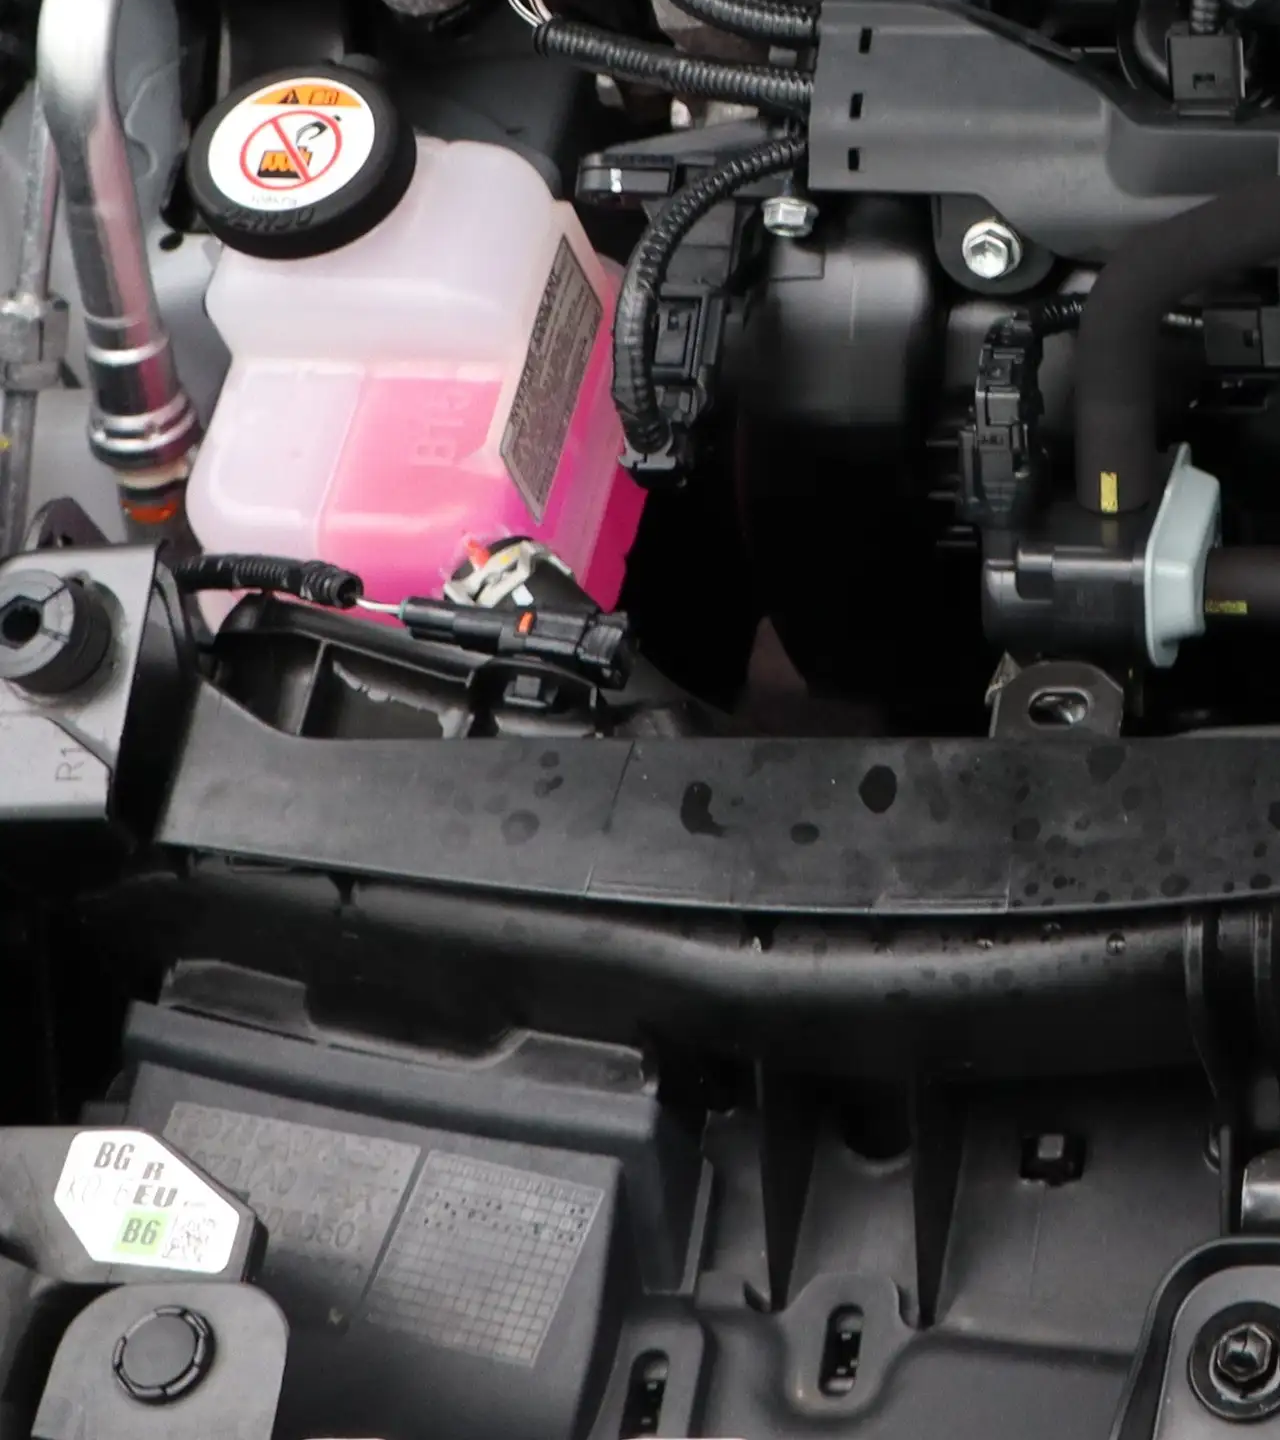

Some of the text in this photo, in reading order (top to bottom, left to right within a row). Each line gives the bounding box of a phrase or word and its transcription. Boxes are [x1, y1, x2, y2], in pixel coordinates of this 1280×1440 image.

[94, 1141, 135, 1170] BG
[133, 1184, 178, 1208] EU
[121, 1217, 161, 1245] B6
